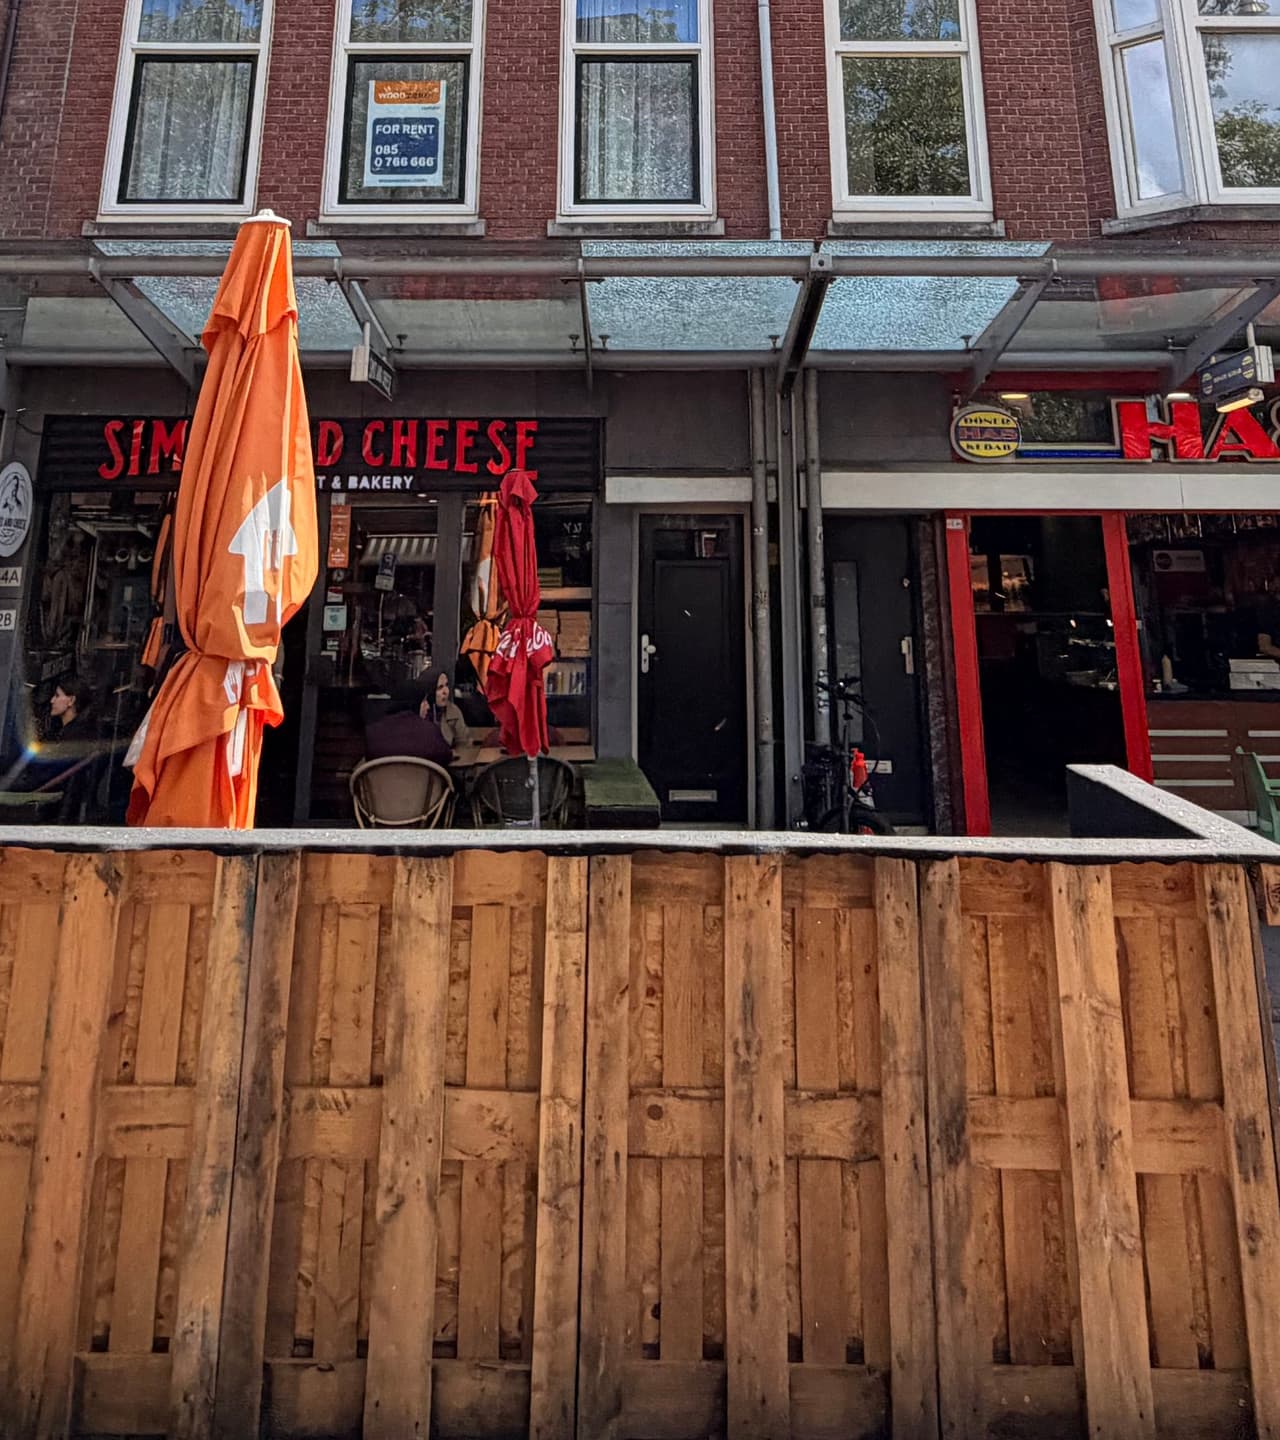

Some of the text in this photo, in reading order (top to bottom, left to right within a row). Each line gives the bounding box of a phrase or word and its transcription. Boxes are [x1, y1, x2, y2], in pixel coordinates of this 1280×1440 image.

[375, 124, 435, 135] FOR RENT
[375, 144, 399, 155] 085
[374, 157, 383, 167] 0
[98, 420, 189, 480] SIM
[362, 420, 540, 481] CHEESE
[331, 476, 342, 490] &
[348, 475, 414, 490] BAKERY
